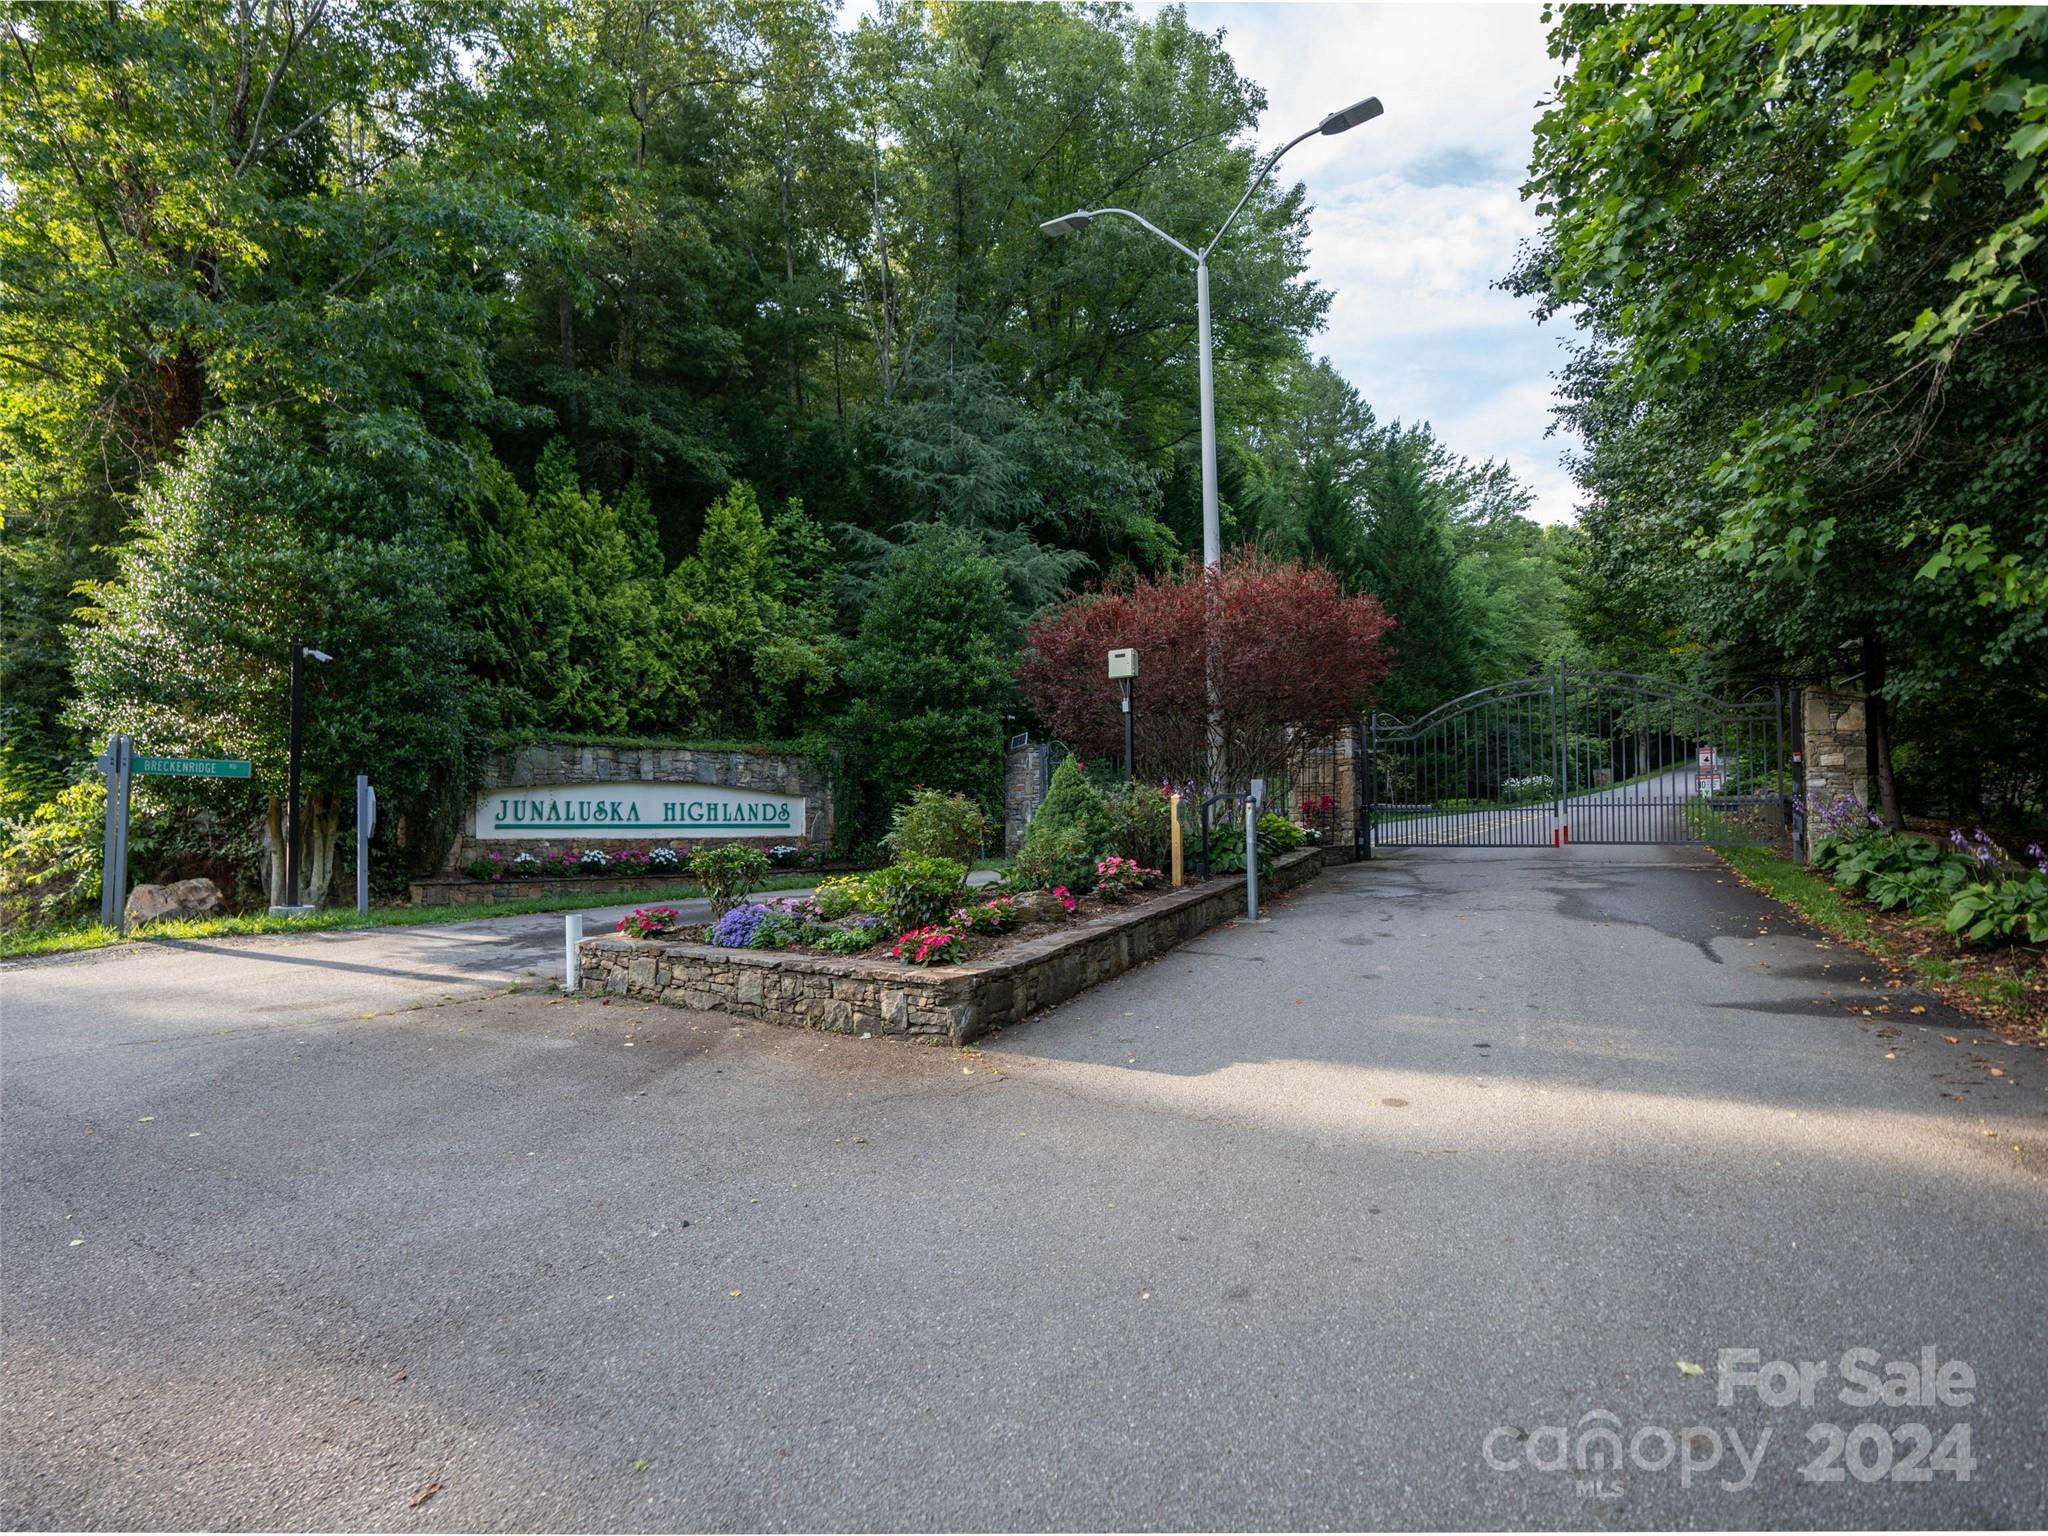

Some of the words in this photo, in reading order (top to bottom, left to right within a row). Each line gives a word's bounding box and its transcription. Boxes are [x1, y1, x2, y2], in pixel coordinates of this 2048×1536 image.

[144, 760, 217, 774] BRECKENRIDGE
[496, 800, 641, 822] JUNALUSKA
[663, 802, 791, 822] HIGHLANDS
